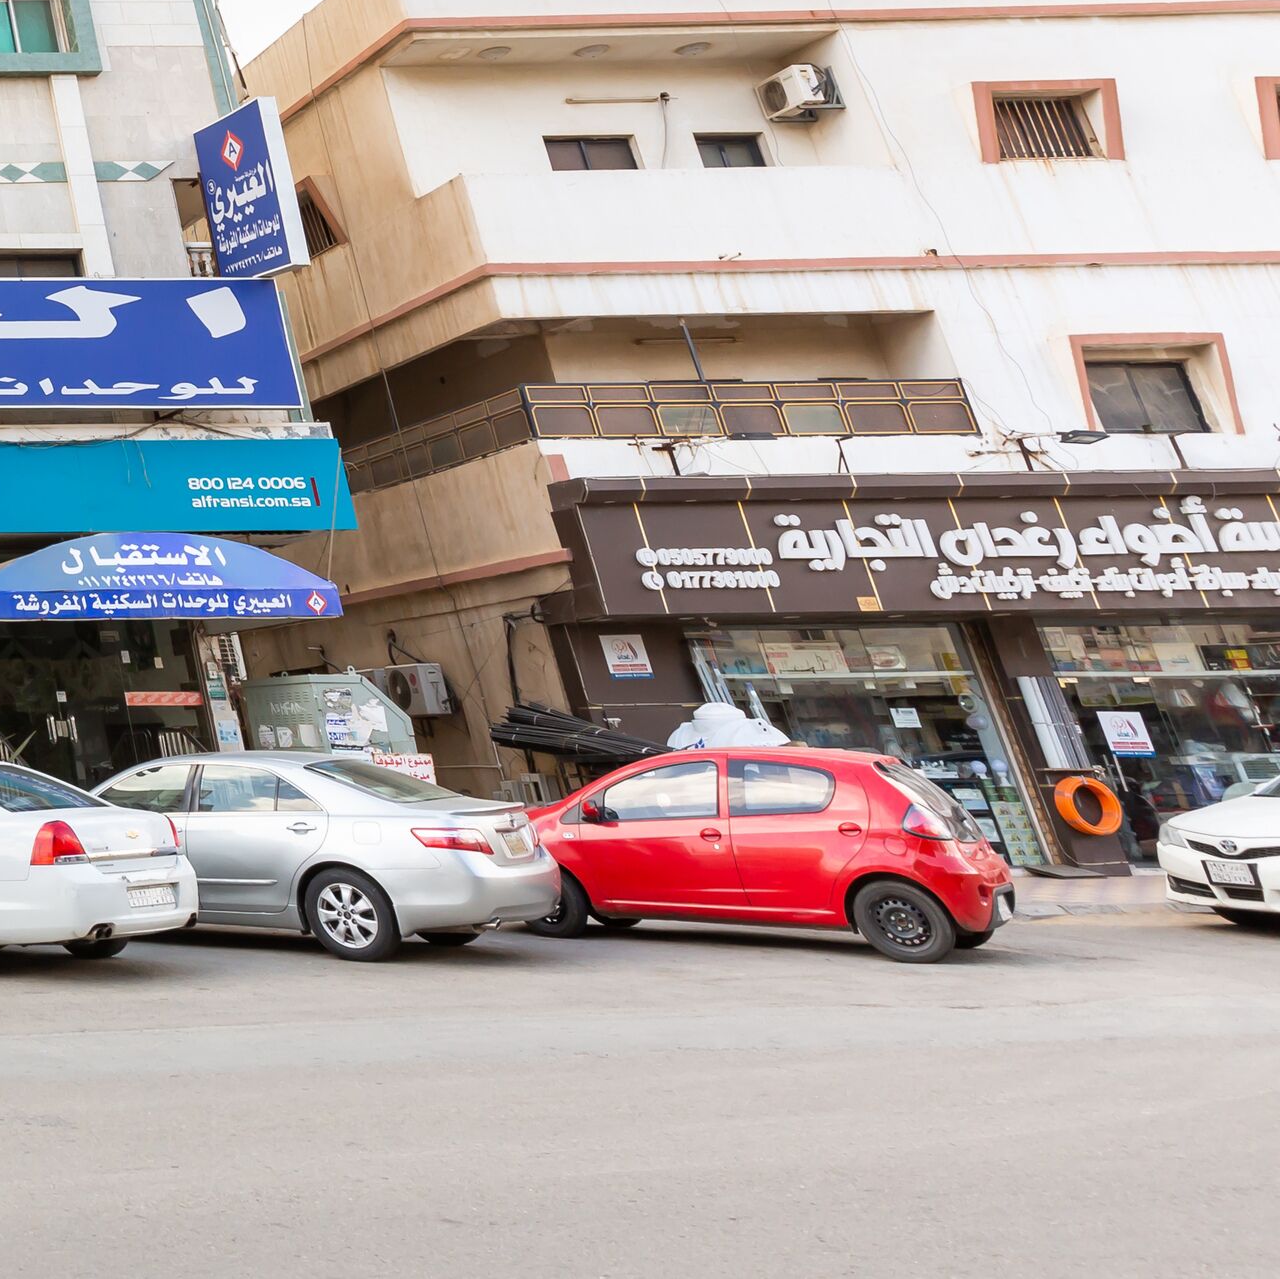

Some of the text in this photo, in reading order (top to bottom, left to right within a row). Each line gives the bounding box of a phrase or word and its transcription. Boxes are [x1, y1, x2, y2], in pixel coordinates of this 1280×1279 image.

[228, 142, 237, 158] A
[187, 476, 307, 491] 800 124 0006
[191, 495, 312, 509] alfransi.com.sa
[773, 513, 939, 571] التجارية
[939, 510, 1077, 570] رغدان
[1078, 495, 1219, 567] أضواء
[61, 543, 226, 577] الاستقبال
[15, 591, 292, 616] العييري للوحدات السكنية المفروشة
